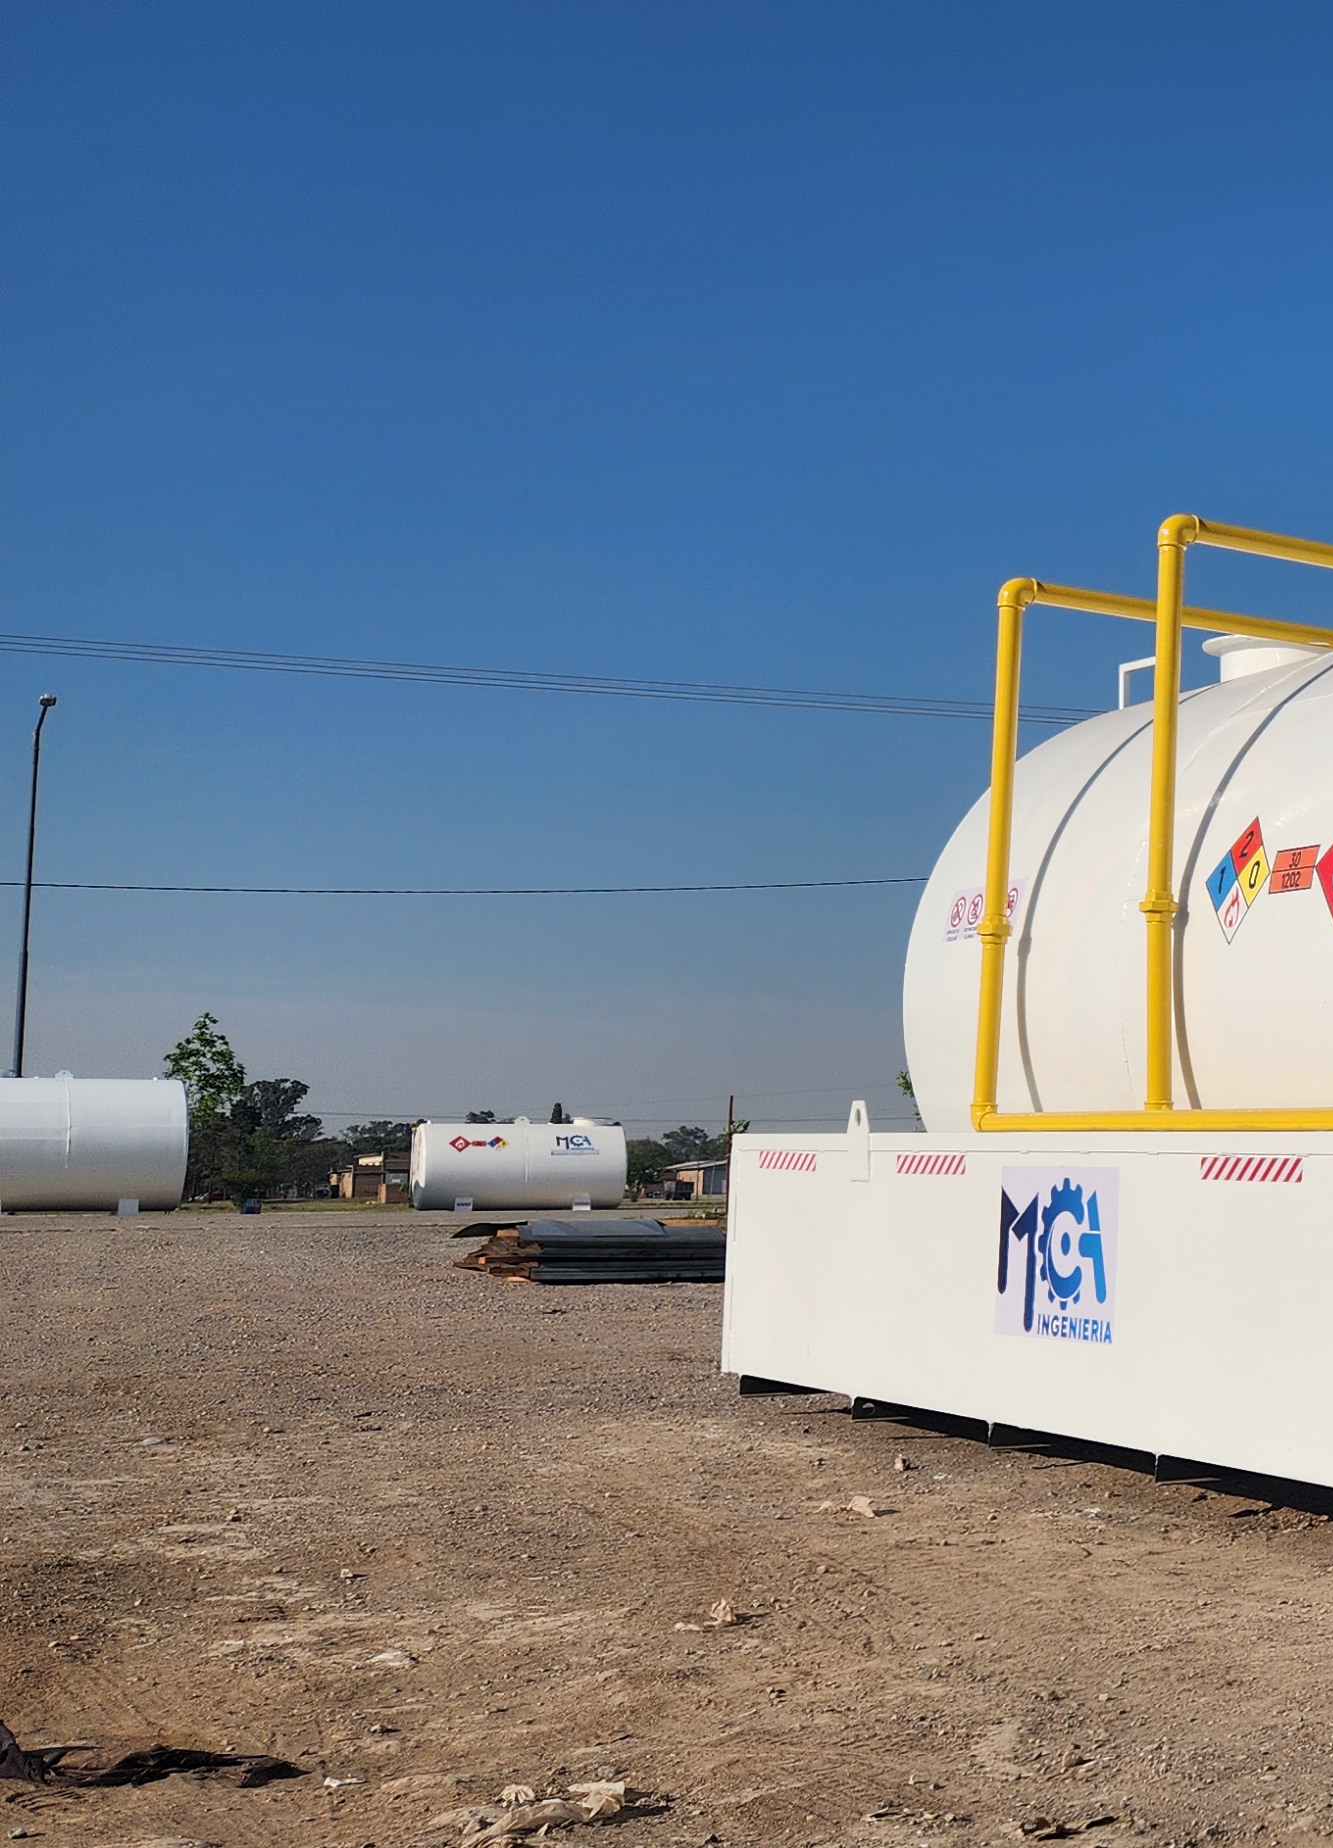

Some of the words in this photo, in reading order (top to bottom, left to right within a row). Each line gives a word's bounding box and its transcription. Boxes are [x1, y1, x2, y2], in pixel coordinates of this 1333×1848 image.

[1239, 830, 1254, 858] 2
[1289, 852, 1301, 868] 30
[1218, 866, 1227, 894] 1
[1249, 860, 1260, 889] 0
[1281, 871, 1301, 889] 1202
[1037, 1314, 1112, 1344] INGENIERIA
